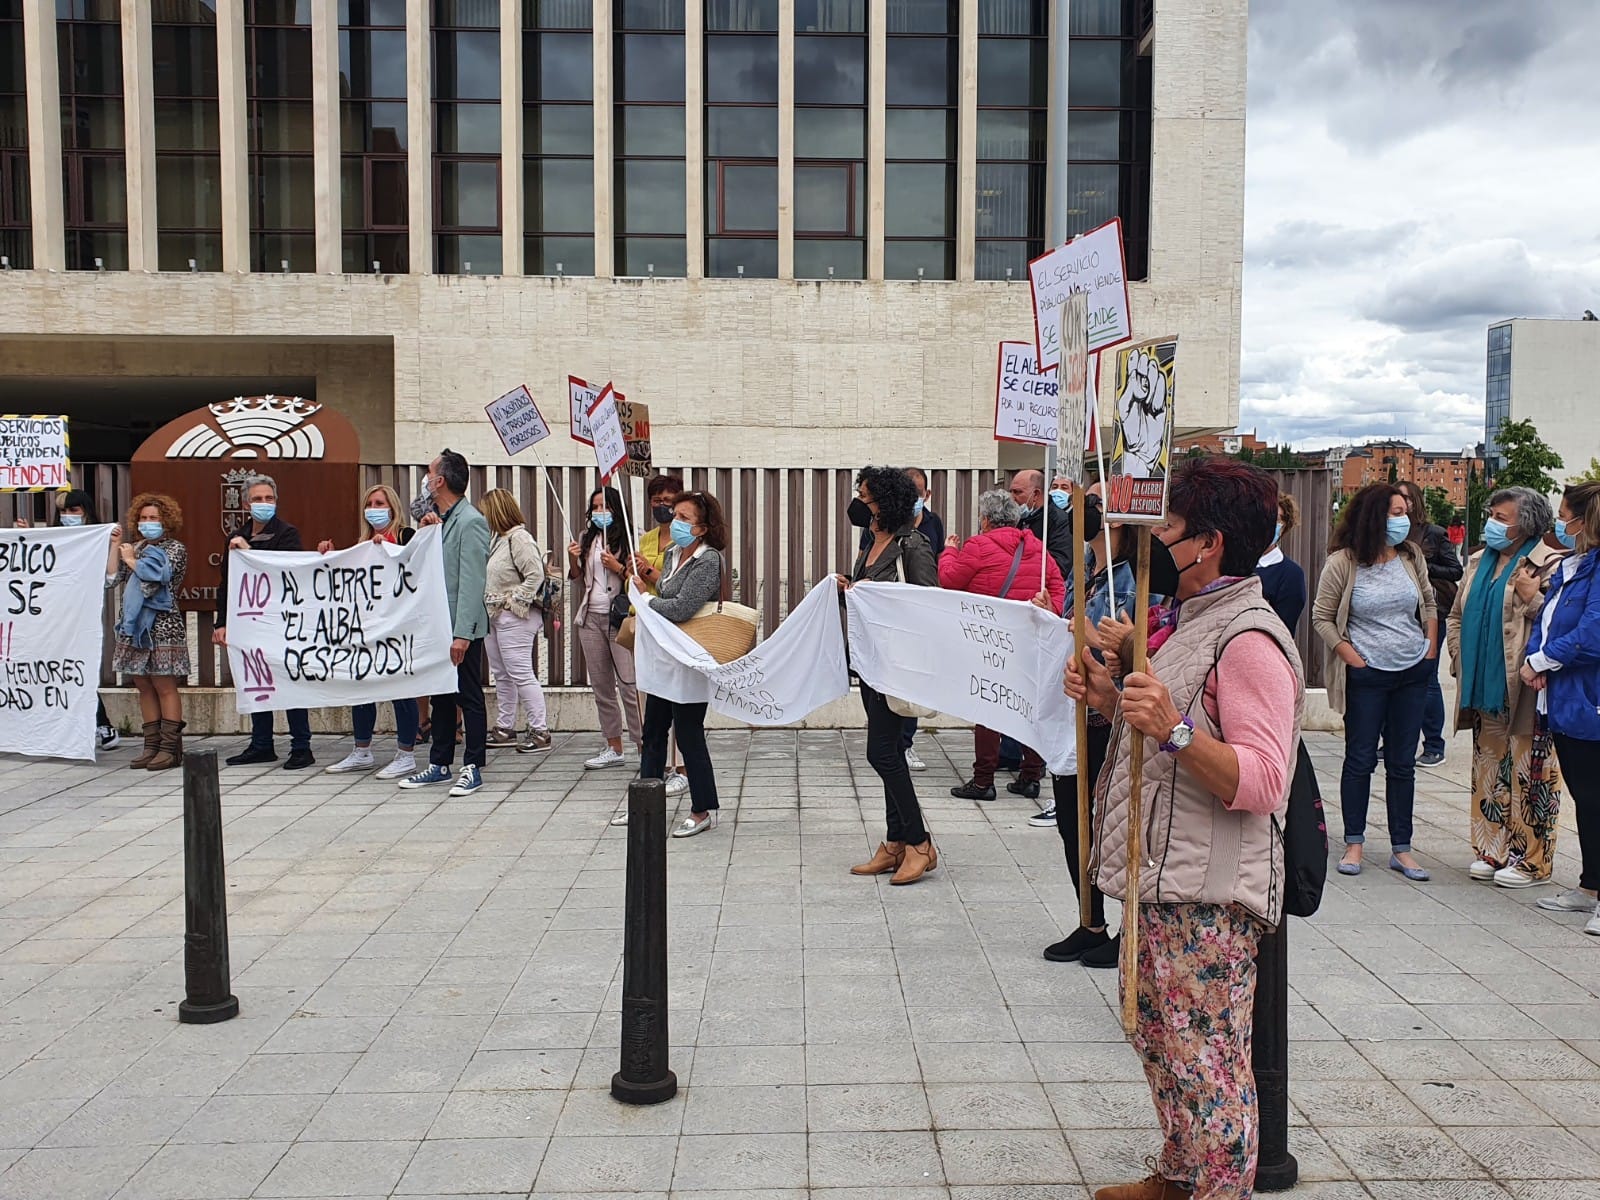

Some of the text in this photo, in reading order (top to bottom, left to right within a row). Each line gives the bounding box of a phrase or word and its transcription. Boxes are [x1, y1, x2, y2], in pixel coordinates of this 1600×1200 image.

[1053, 250, 1100, 286] SERVICIO
[1003, 376, 1019, 392] SE
[0, 464, 66, 486] IENDEN!
[1107, 473, 1133, 513] NO
[8, 580, 46, 615] SE
[239, 572, 271, 608] NO
[281, 571, 304, 605] AL
[960, 619, 1015, 653] HEROES
[6, 660, 85, 687] MENORES
[241, 647, 274, 687] NO
[983, 650, 1006, 670] HOY
[45, 686, 69, 710] EN
